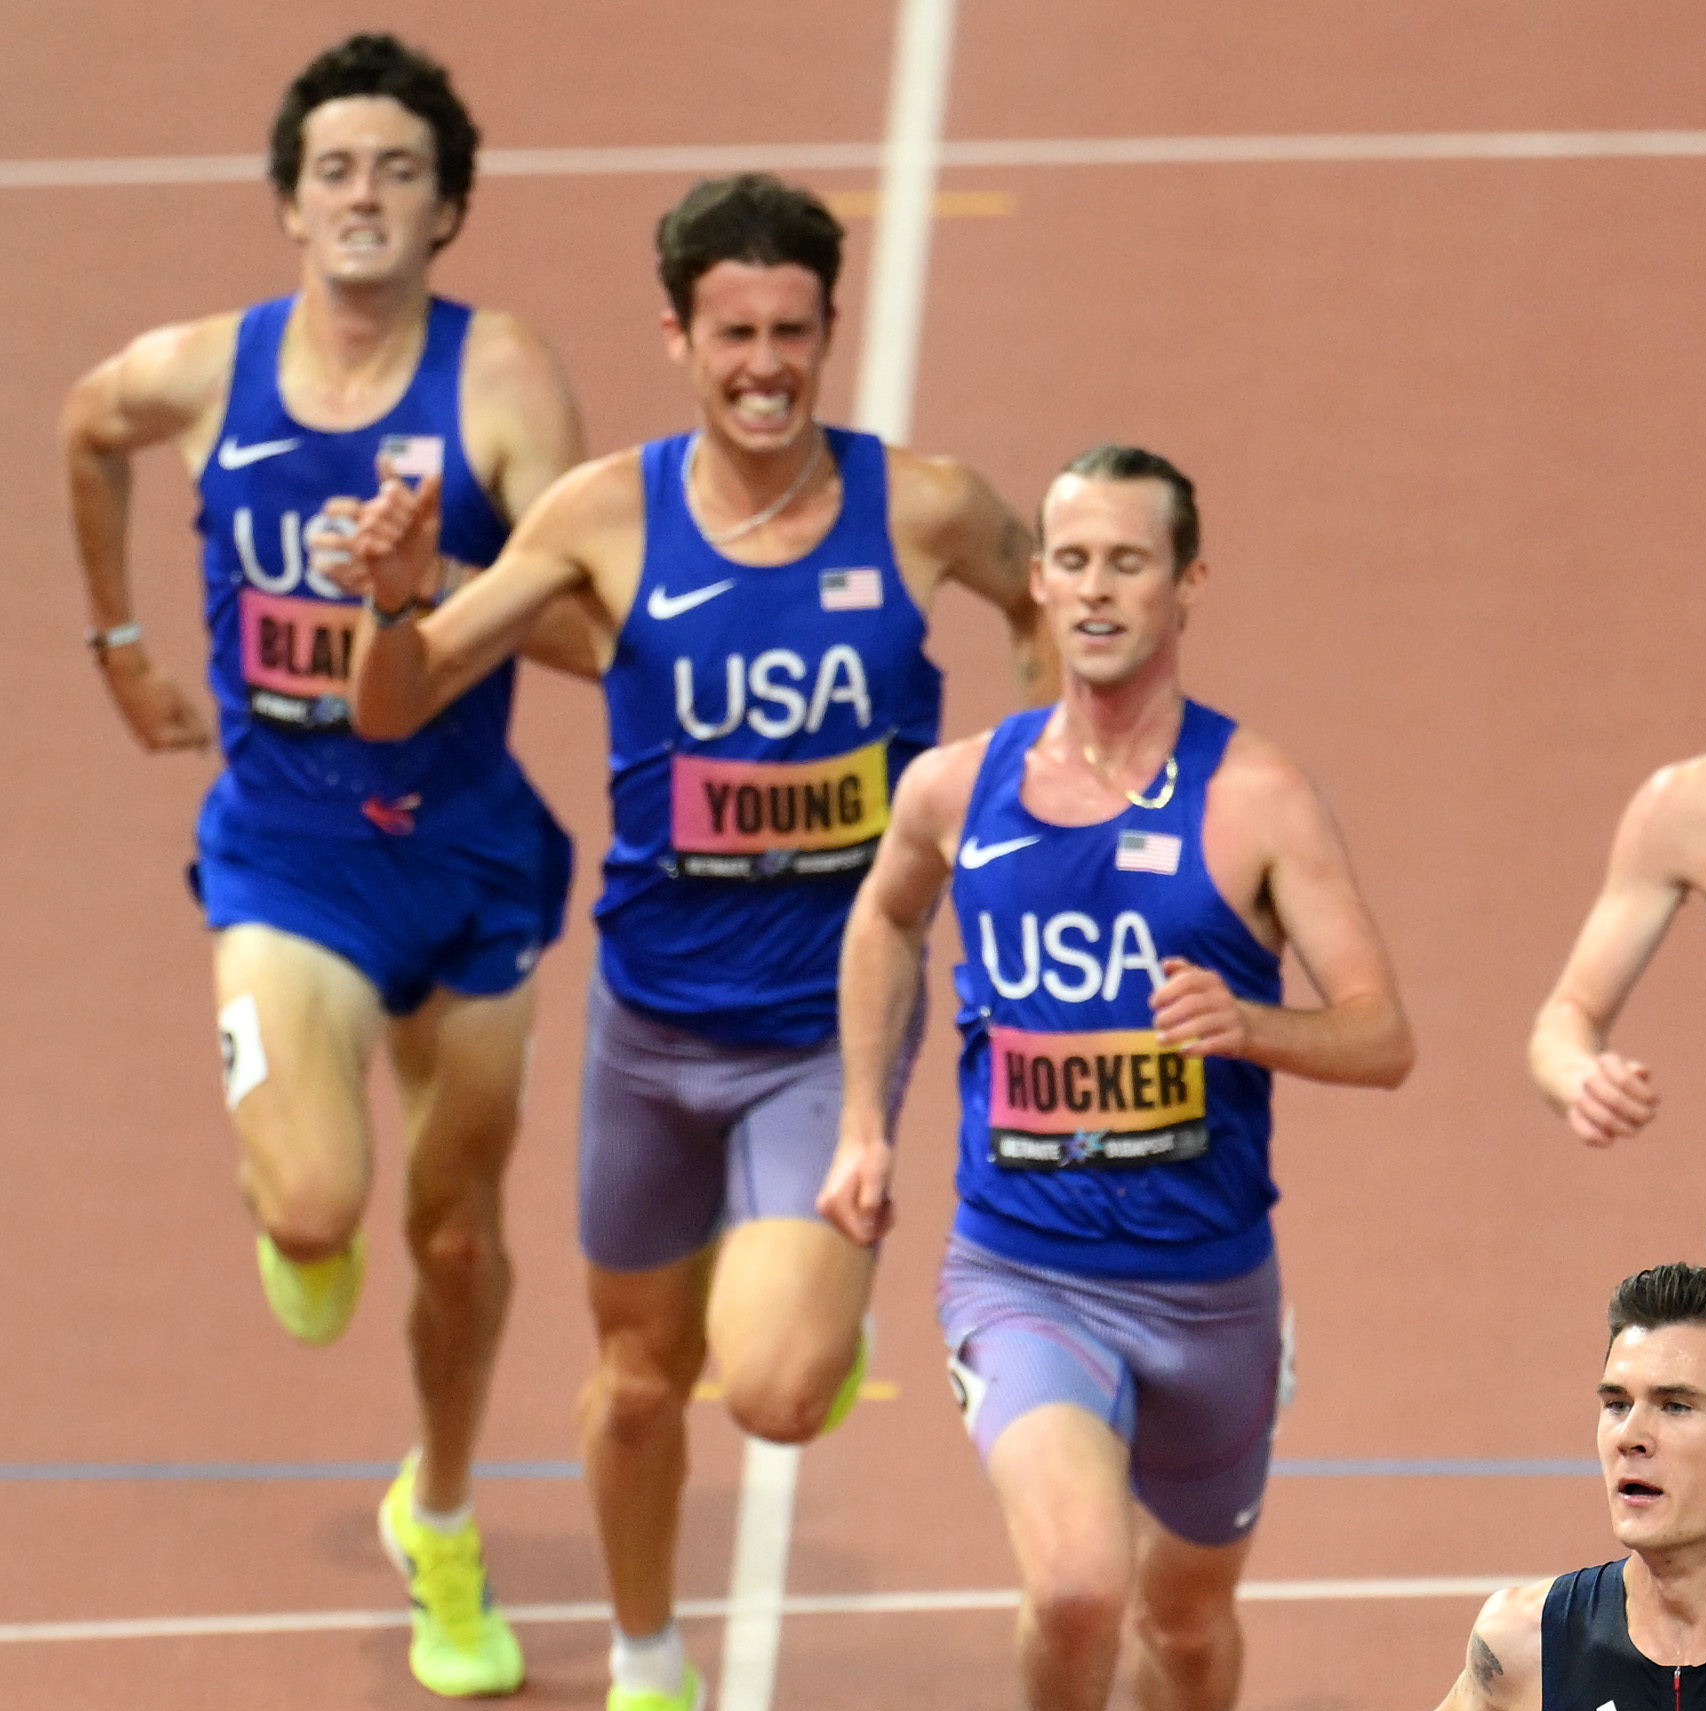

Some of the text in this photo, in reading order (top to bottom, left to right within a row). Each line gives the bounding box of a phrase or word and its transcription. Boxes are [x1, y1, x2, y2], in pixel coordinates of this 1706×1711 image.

[259, 615, 355, 678] BLA
[673, 645, 872, 740] USA
[704, 775, 864, 837] YOUNG
[978, 911, 1170, 1001] USA
[1004, 1050, 1188, 1114] HOCKER
